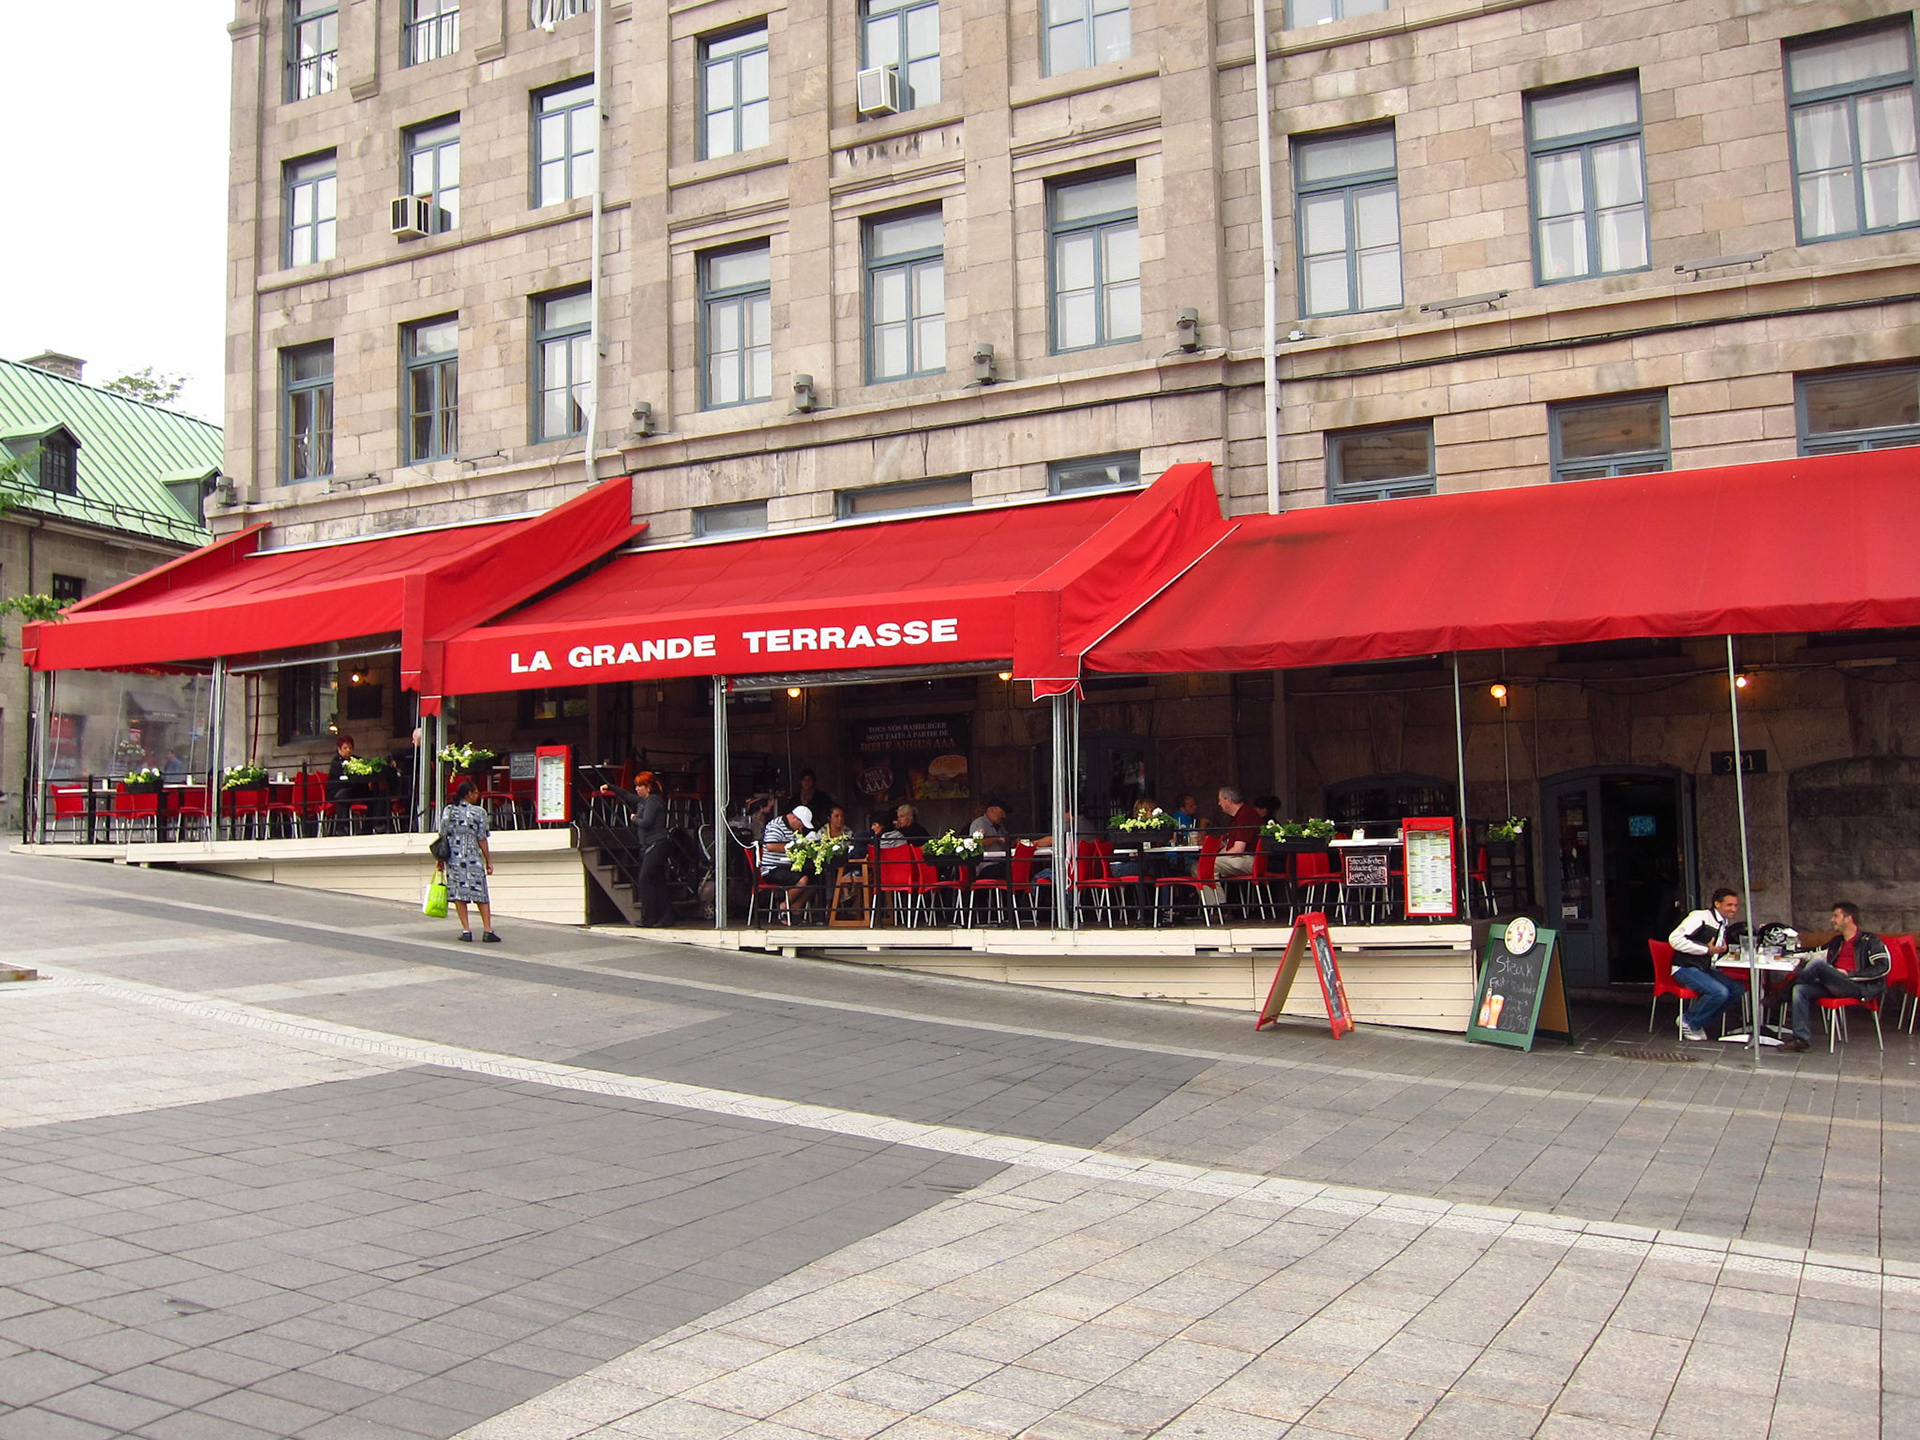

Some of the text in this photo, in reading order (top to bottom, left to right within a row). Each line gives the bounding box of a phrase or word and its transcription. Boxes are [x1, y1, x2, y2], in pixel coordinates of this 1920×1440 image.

[510, 618, 958, 674] LA GRANDE TERRASSE
[868, 722, 947, 733] TOUS NOS HAMBURGER
[865, 733, 885, 741] SONT
[885, 732, 906, 740] FAITS
[913, 730, 938, 738] PARTIR
[896, 739, 932, 750] ANGUS
[935, 738, 956, 748] AAA
[1723, 754, 1755, 772] 31
[865, 780, 889, 794] AAA
[1495, 955, 1535, 978] Steak
